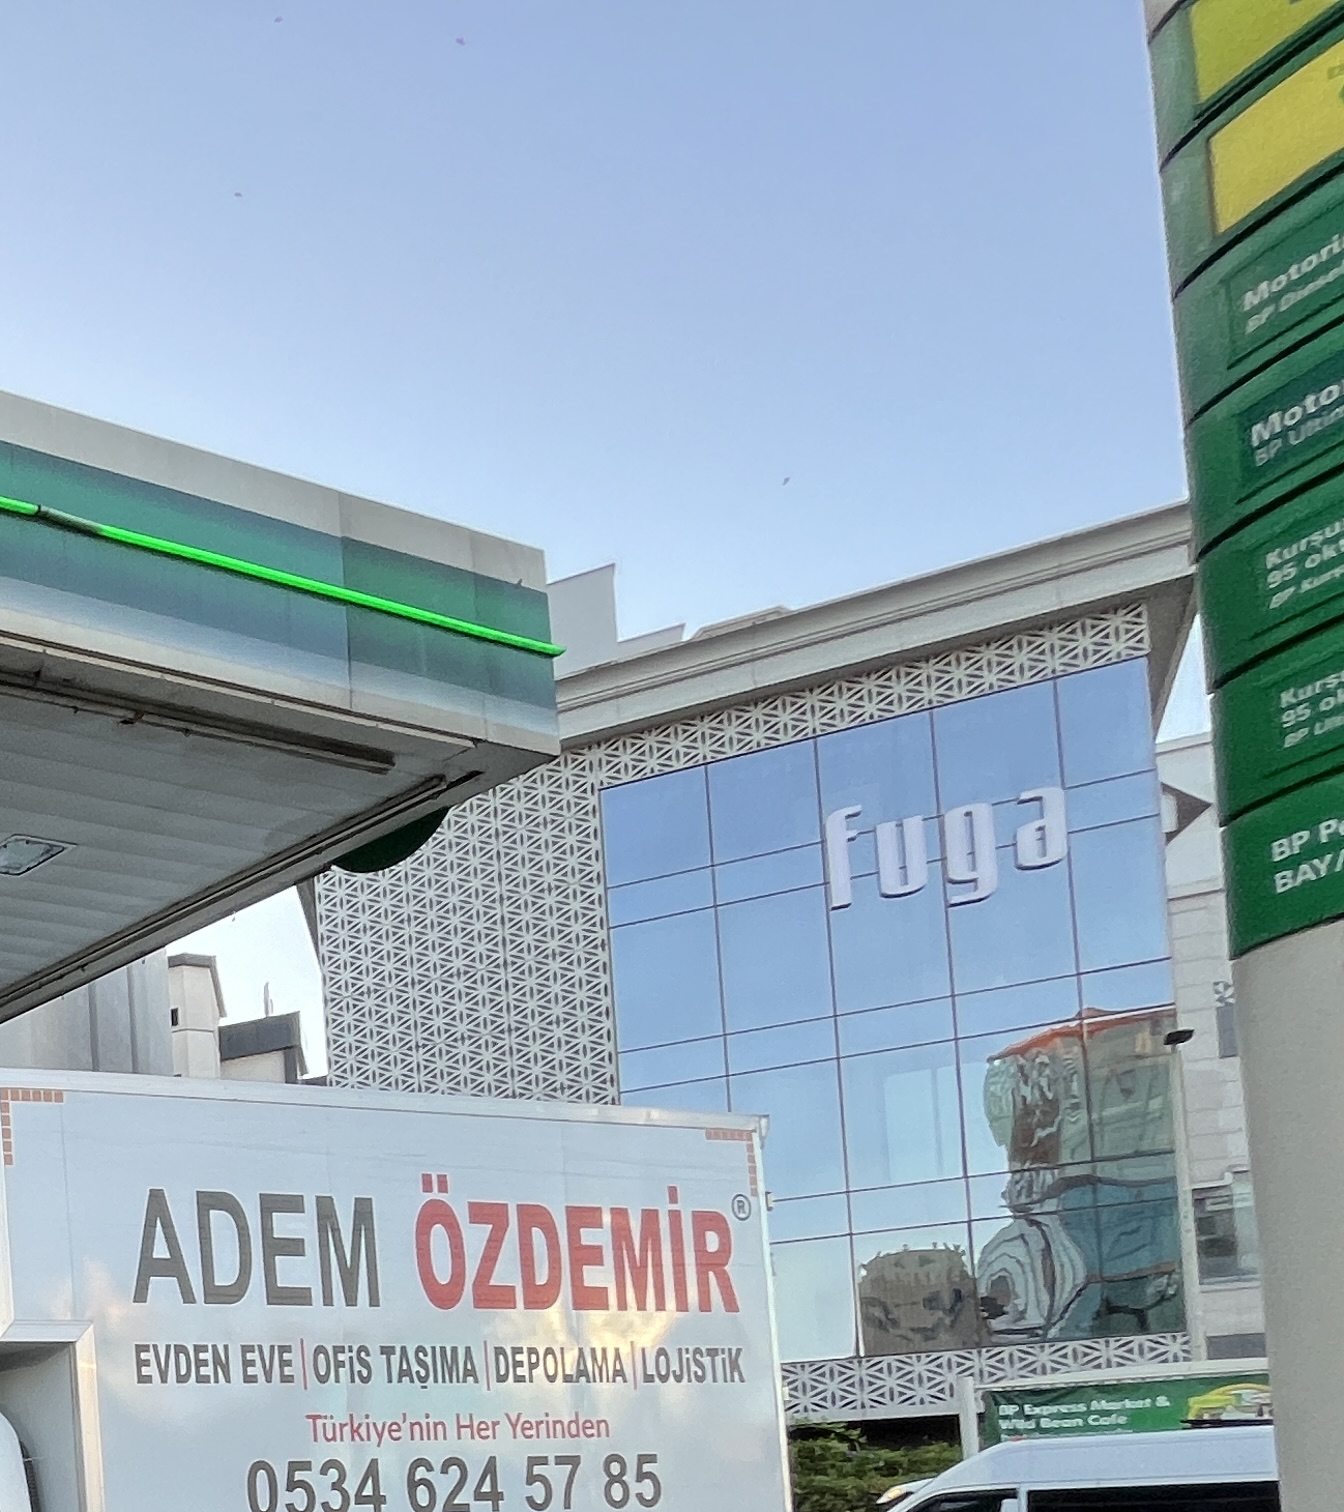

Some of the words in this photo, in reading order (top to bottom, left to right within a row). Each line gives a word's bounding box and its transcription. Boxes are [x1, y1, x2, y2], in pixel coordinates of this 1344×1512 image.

[1243, 233, 1344, 311] Motori
[1265, 518, 1344, 569] Kurşu
[1267, 561, 1298, 589] 95
[1282, 702, 1312, 728] 95
[823, 785, 1068, 909] fuga
[1271, 830, 1311, 862] BP
[132, 1187, 380, 1308] ADEM
[414, 1172, 740, 1313] ÖZDEMİR
[134, 1342, 231, 1385] EVDEN
[241, 1342, 295, 1384] EVE
[379, 1345, 479, 1390] TAŞIMA
[494, 1345, 627, 1385] DEPOLAMA
[1024, 1402, 1087, 1416] Express
[1090, 1398, 1152, 1410] Market
[1155, 1395, 1170, 1407] &
[1040, 1417, 1083, 1429] Bean
[1087, 1414, 1129, 1425] Cafe
[455, 1413, 501, 1441] Her
[504, 1411, 610, 1440] Yerinden
[524, 1454, 582, 1512] 57
[603, 1453, 663, 1510] 85
